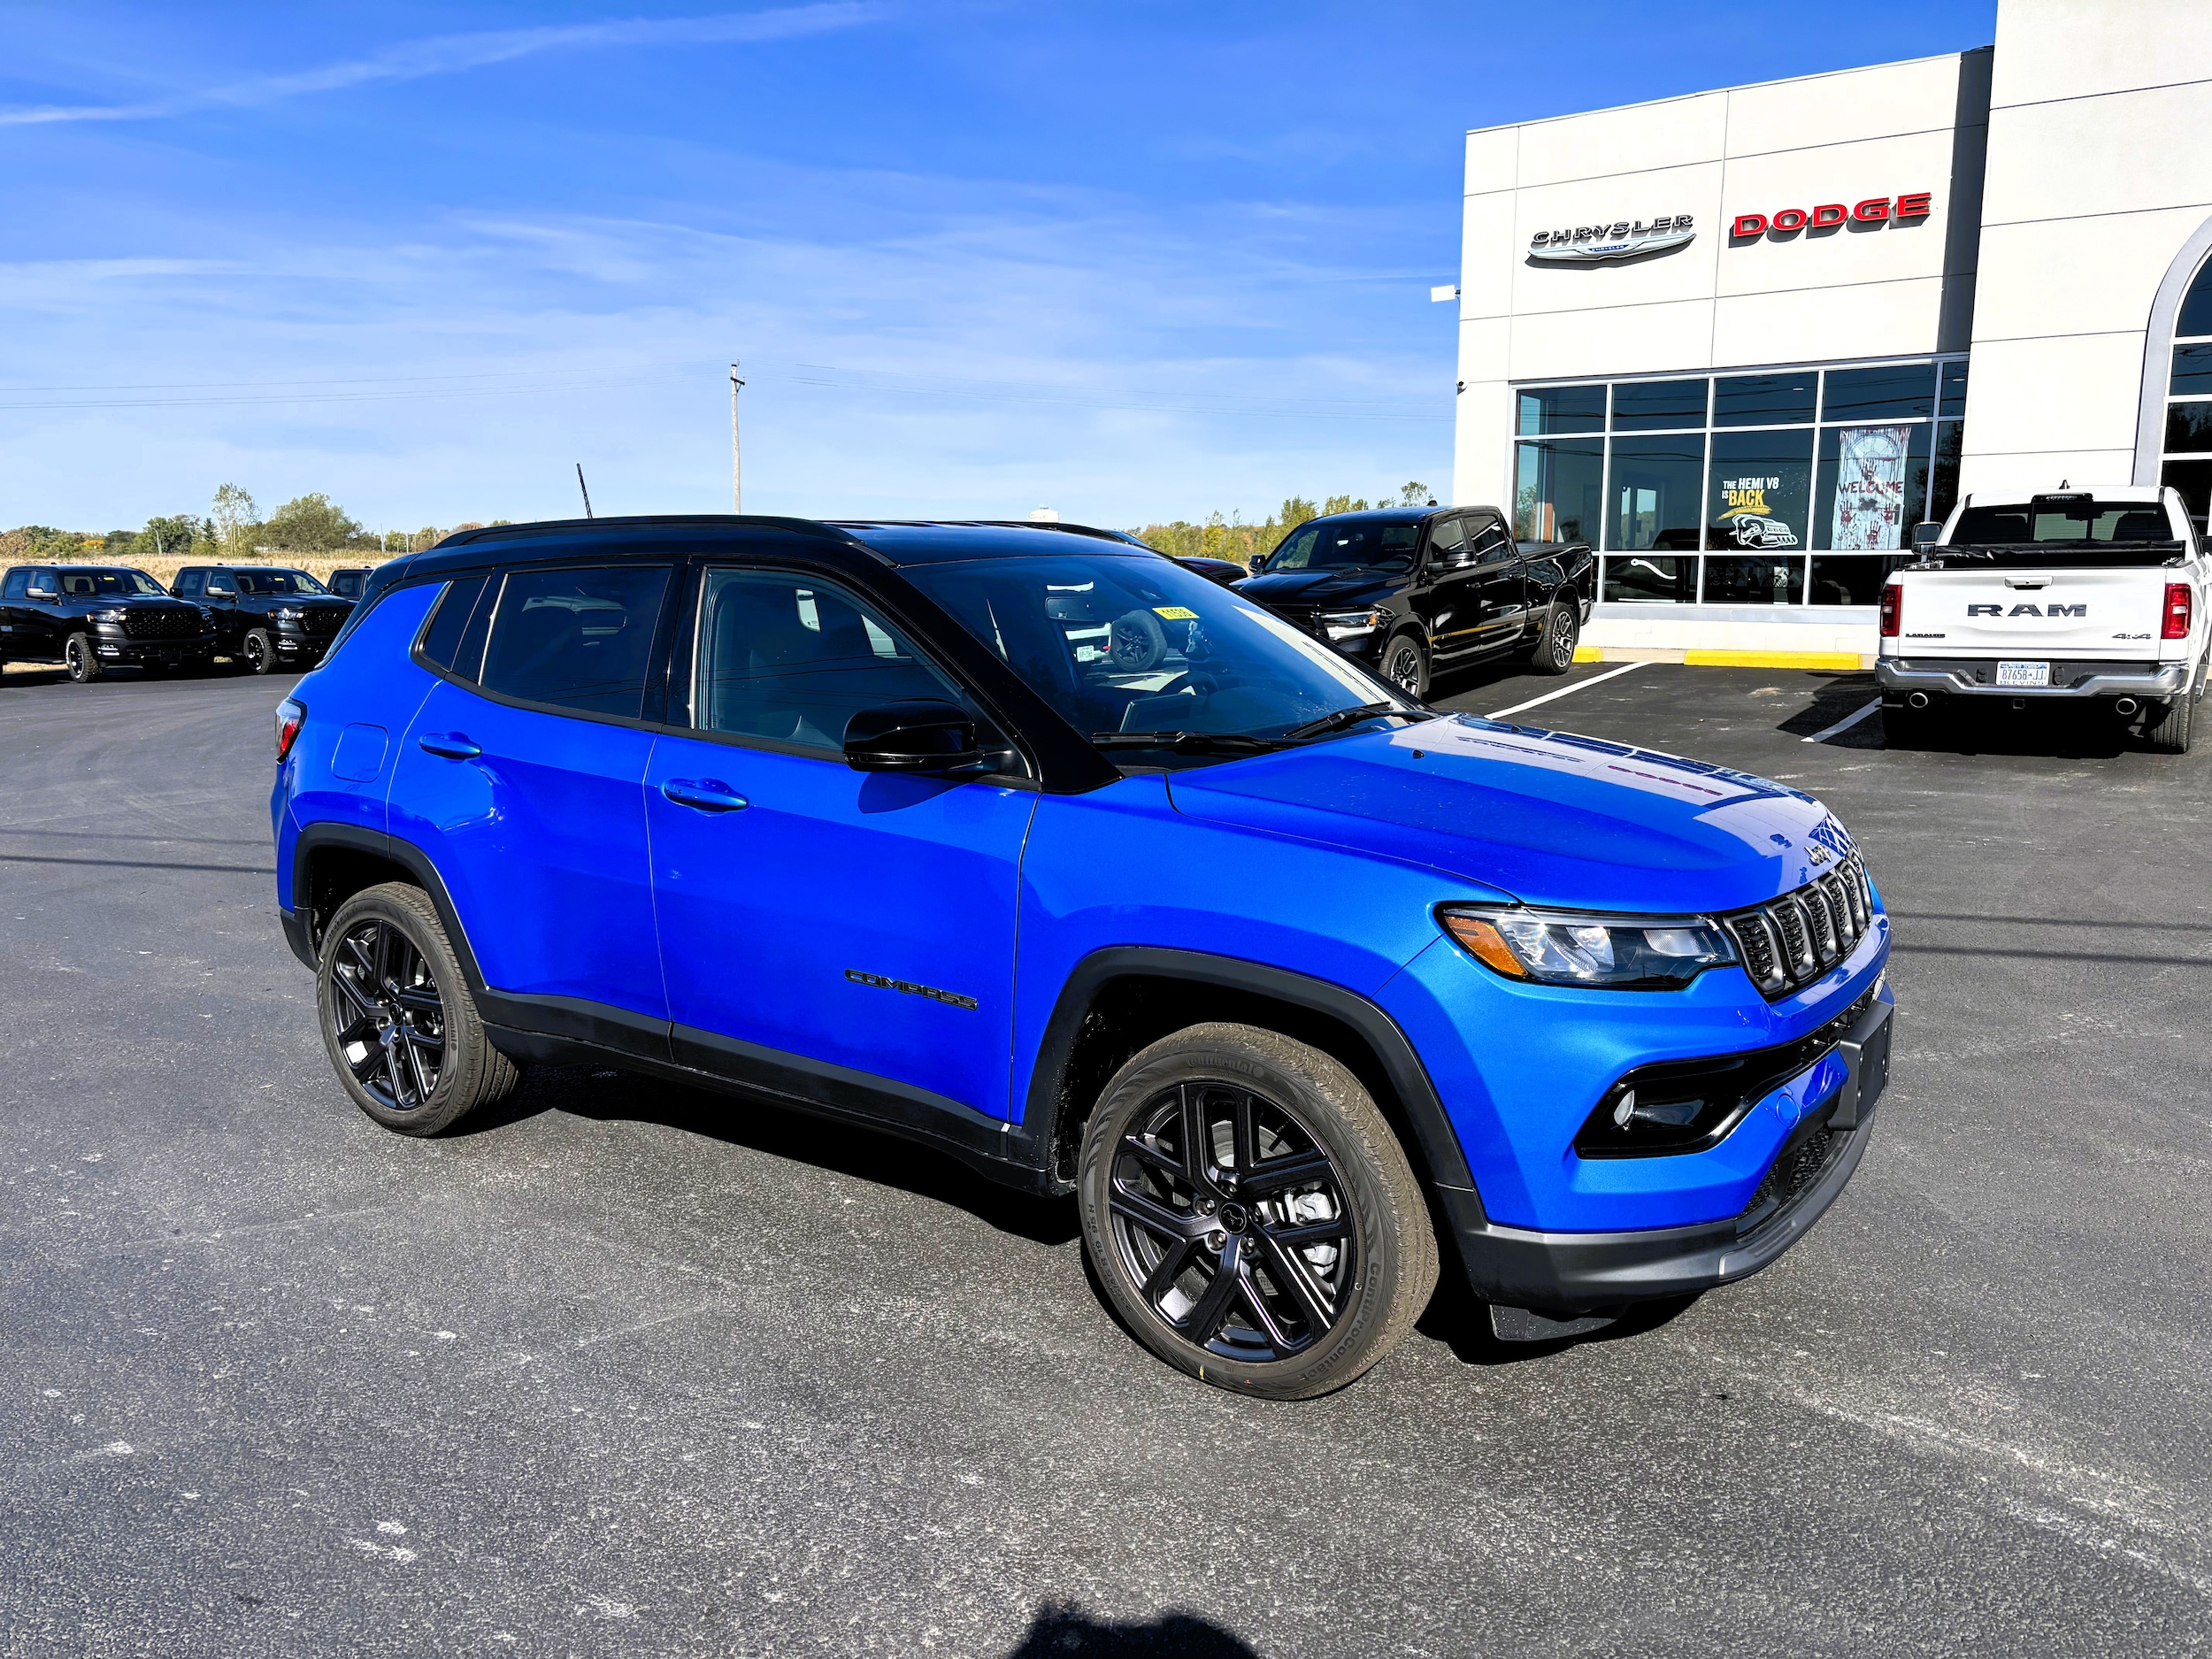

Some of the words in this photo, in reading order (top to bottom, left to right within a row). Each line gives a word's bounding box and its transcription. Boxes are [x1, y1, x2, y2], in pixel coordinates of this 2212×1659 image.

[1733, 192, 1932, 237] DODGE
[1532, 215, 1694, 243] CHRYSLER
[1723, 480, 1737, 489] THE
[1738, 477, 1765, 489] HEMI
[1766, 477, 1779, 489] V8
[1838, 480, 1904, 495] WELCOME
[1721, 490, 1729, 499] IS
[1728, 489, 1765, 506] BACK
[1967, 603, 2087, 617] RAM
[844, 969, 978, 1011] COMPASS
